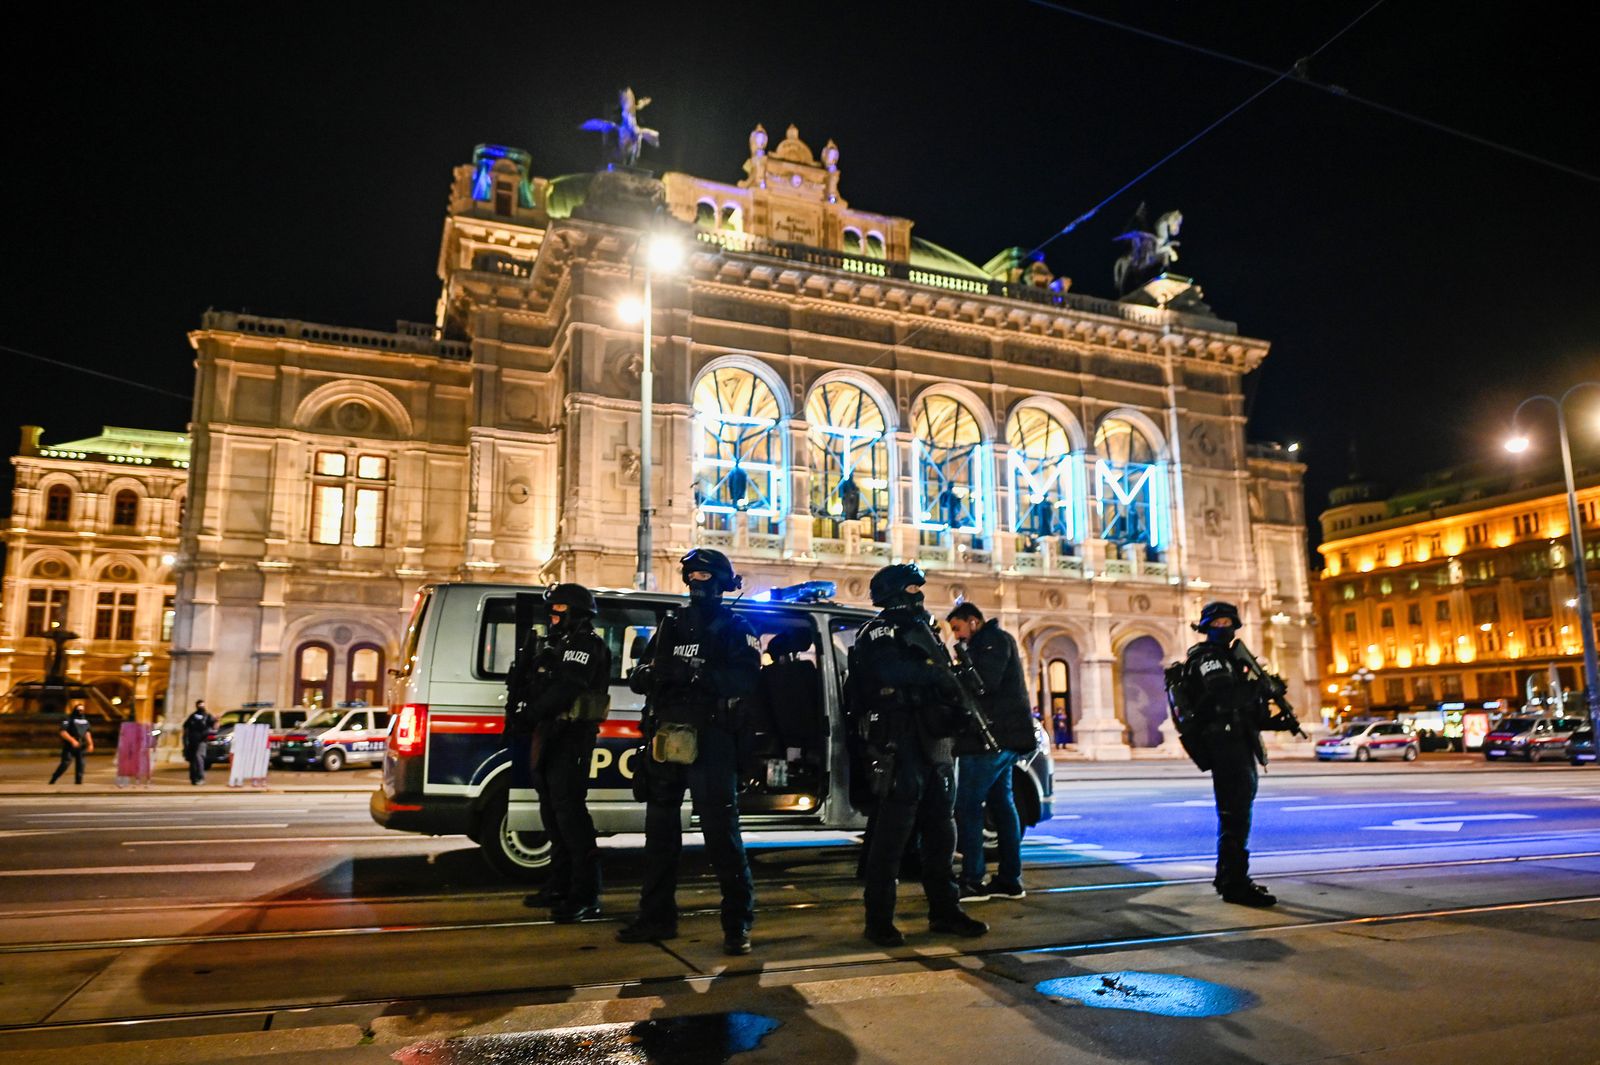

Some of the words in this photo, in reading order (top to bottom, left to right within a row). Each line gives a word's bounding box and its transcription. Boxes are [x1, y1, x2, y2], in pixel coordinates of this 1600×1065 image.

[563, 650, 590, 665] POLIZEI
[673, 644, 700, 657] POLIZEI
[1200, 659, 1222, 676] WEGA
[352, 741, 386, 751] POLIZE
